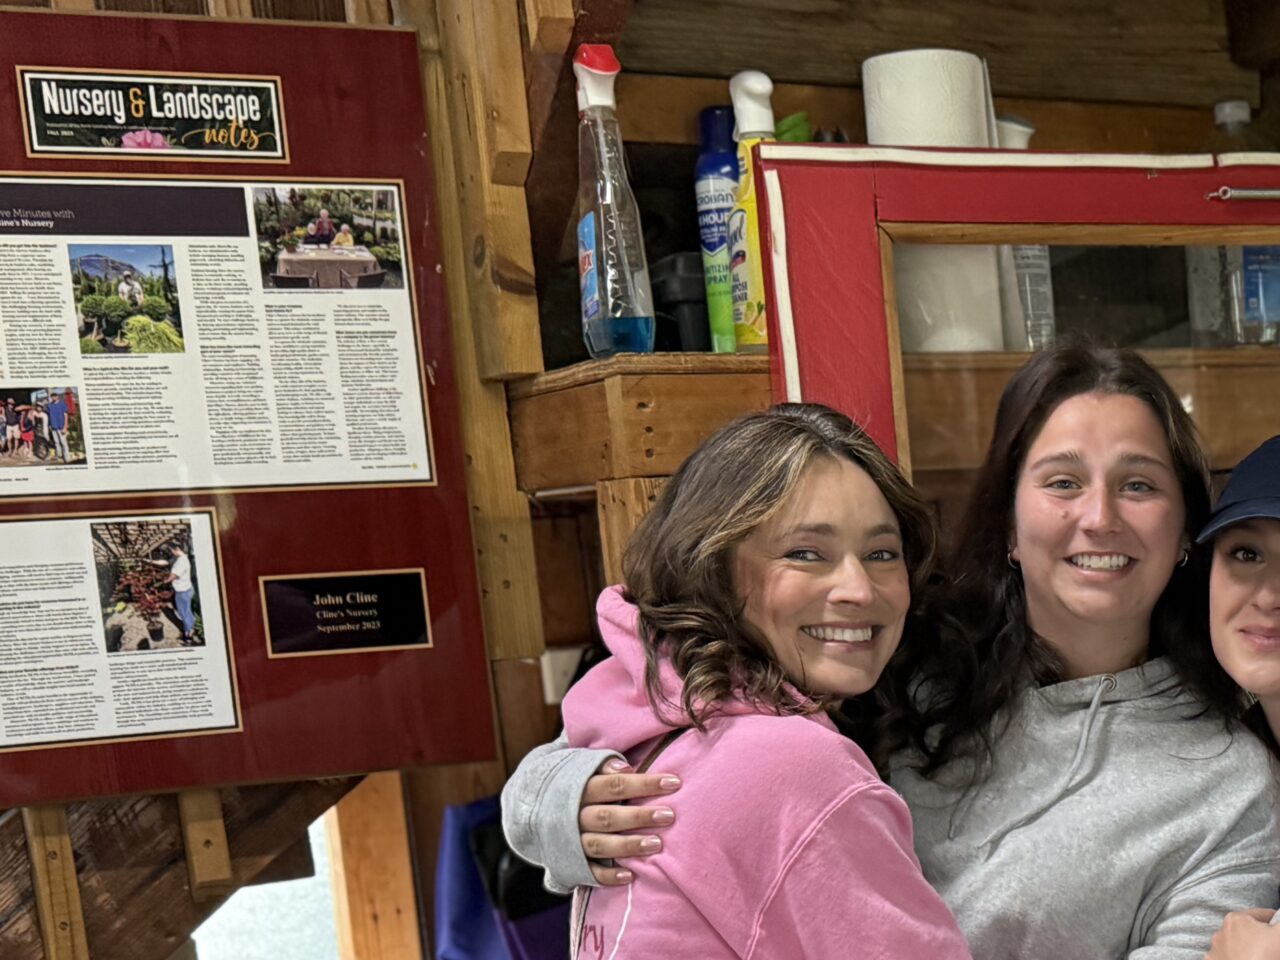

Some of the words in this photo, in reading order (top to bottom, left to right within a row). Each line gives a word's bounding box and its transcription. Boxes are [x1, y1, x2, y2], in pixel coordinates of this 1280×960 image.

[41, 80, 126, 124] Nursery
[129, 87, 146, 118] &
[149, 84, 261, 127] Landscape
[190, 120, 266, 150] notes
[13, 208, 52, 219] Minutes
[53, 209, 76, 219] with
[21, 219, 54, 229] Nursery
[313, 593, 343, 606] John
[346, 592, 378, 604] Cline
[317, 622, 360, 634] September
